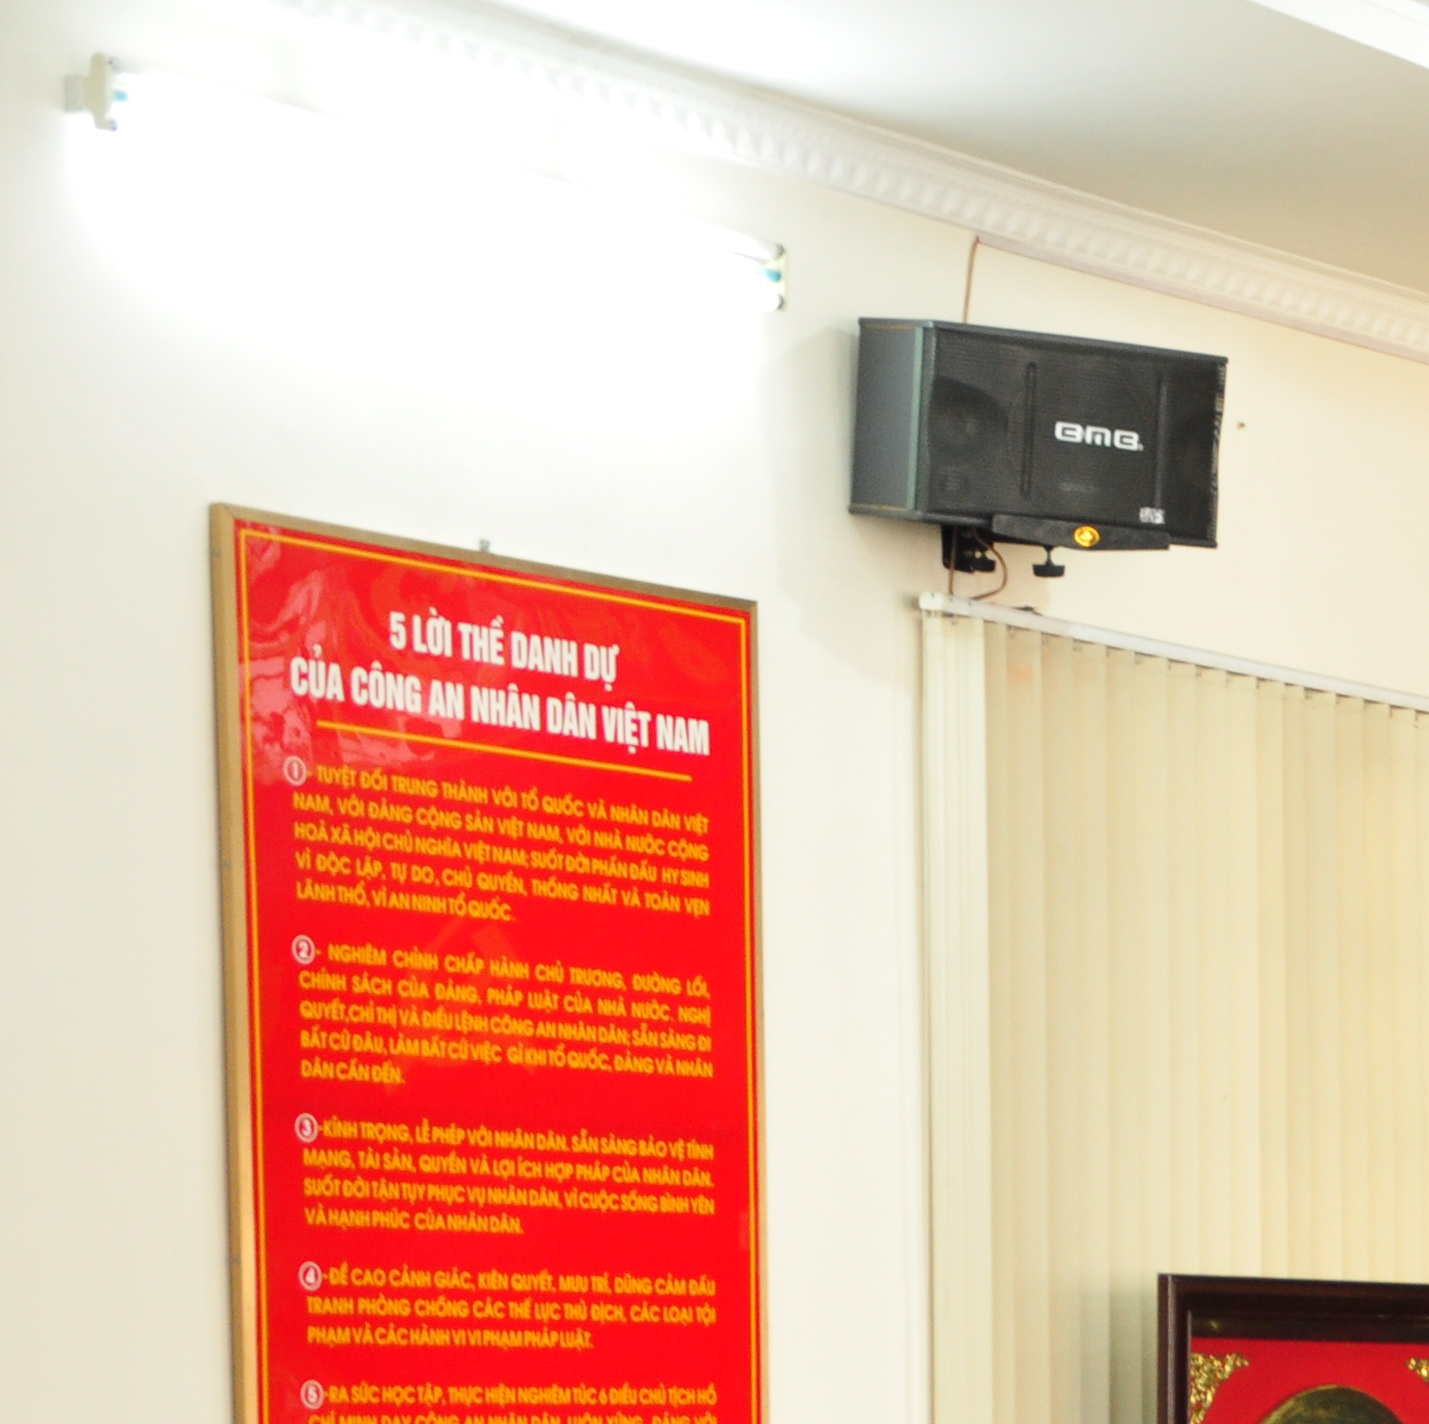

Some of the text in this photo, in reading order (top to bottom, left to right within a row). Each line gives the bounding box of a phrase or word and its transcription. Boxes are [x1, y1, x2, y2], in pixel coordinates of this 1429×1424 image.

[389, 607, 619, 690] 5 LỜI THỀ DANH DỰ
[290, 644, 708, 754] CỦA CÔNG AN NHÂN DÂN VIỆT NAM
